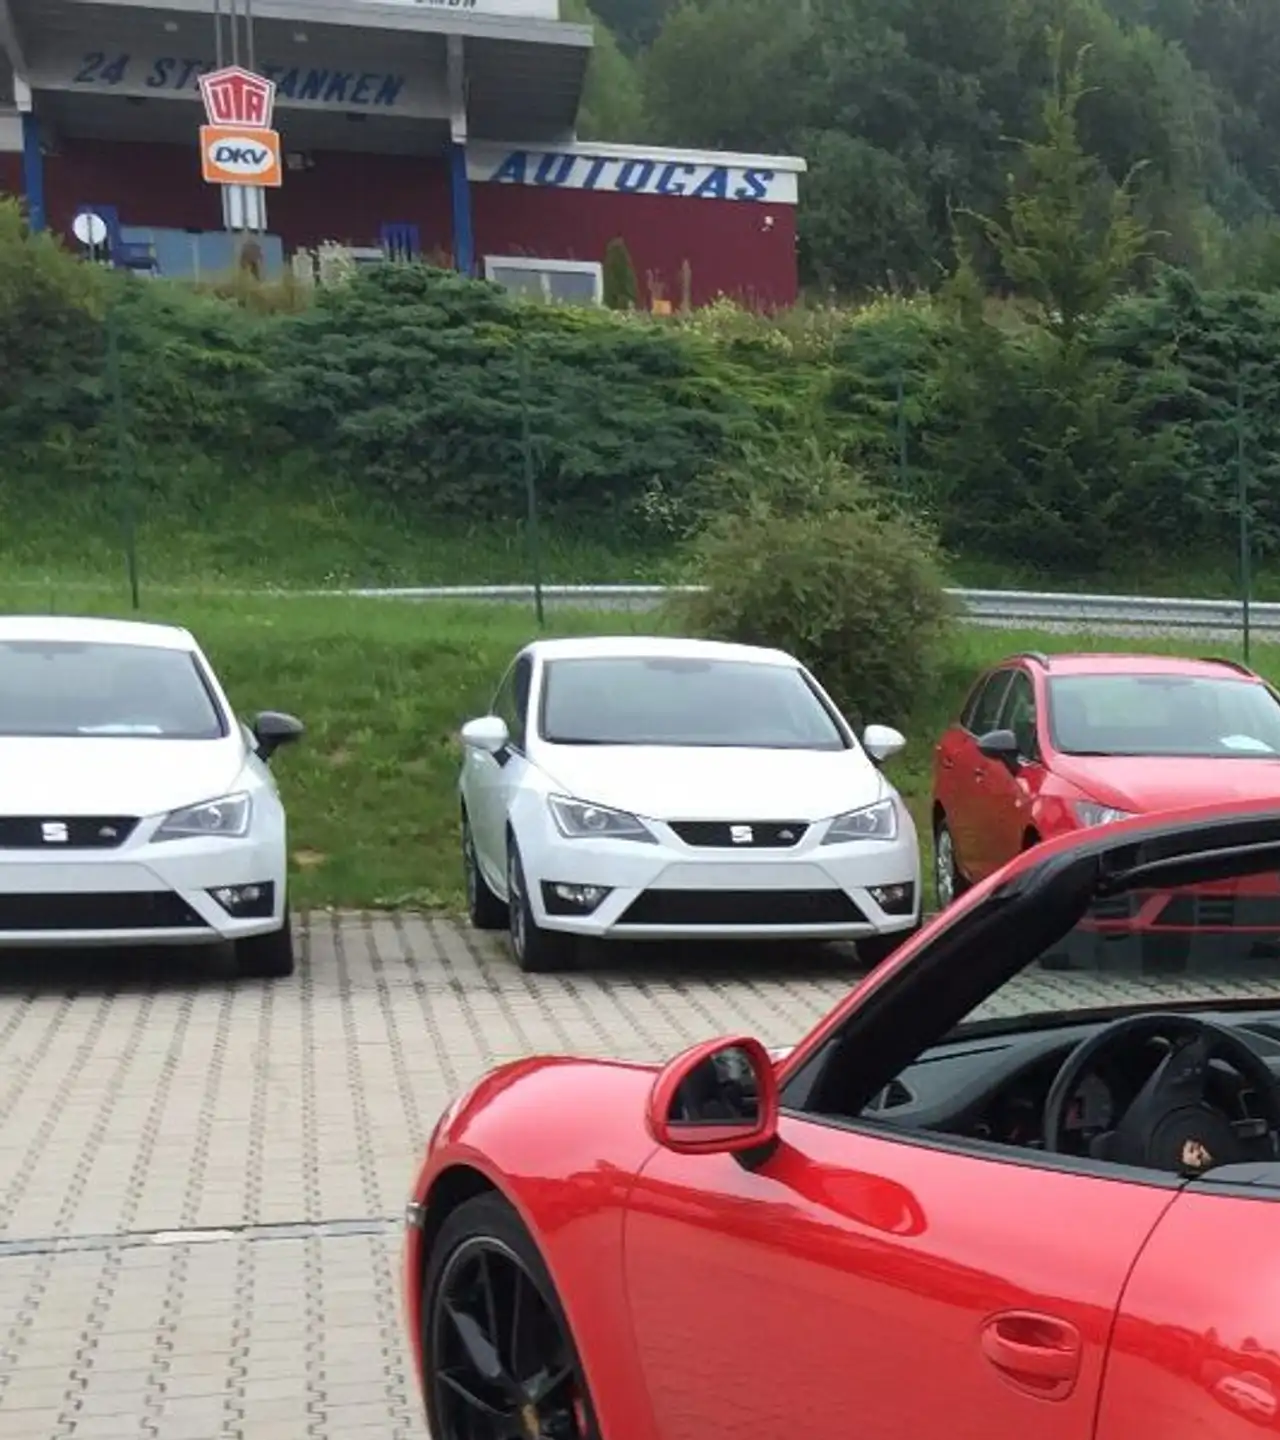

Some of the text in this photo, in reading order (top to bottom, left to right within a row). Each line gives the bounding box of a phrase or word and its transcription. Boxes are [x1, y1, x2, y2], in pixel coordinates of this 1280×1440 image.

[72, 50, 131, 85] 24
[208, 73, 267, 123] UTA
[215, 146, 269, 166] DKV
[490, 150, 774, 201] AUTOGAS
